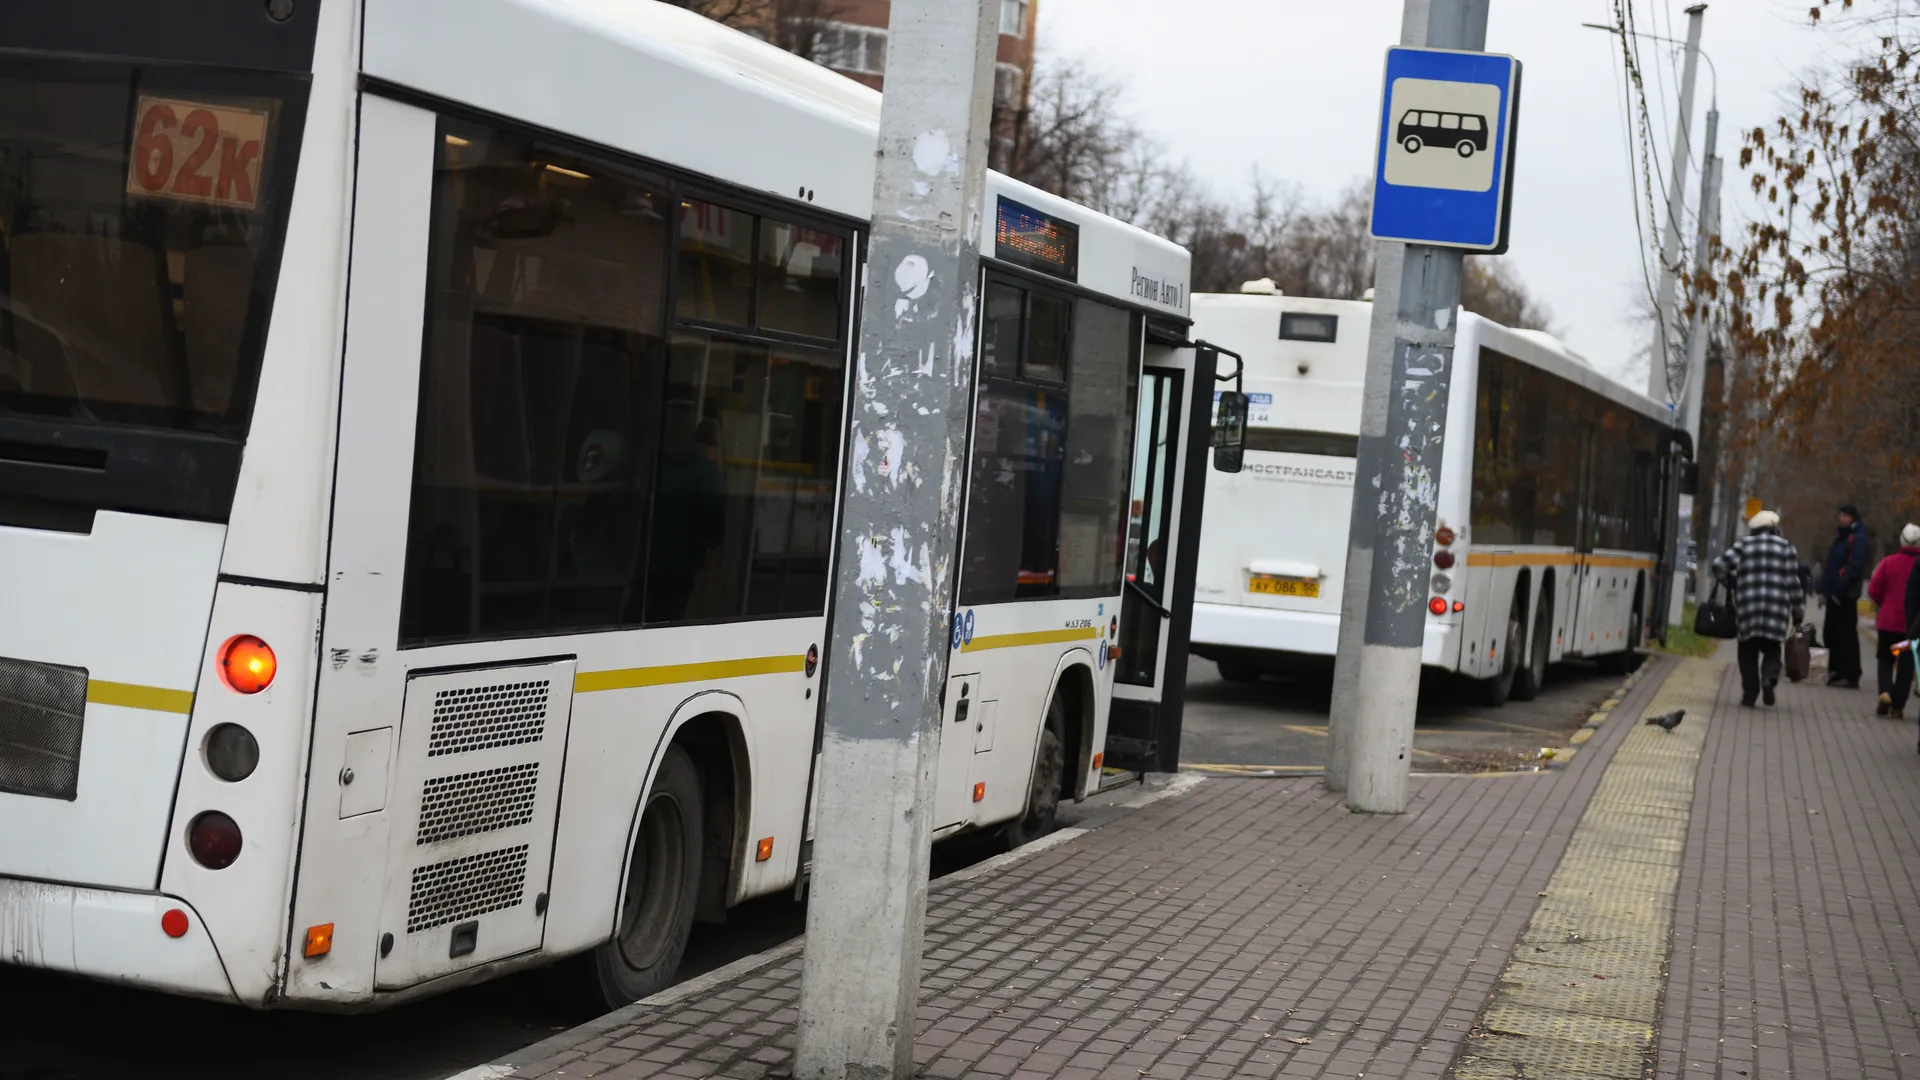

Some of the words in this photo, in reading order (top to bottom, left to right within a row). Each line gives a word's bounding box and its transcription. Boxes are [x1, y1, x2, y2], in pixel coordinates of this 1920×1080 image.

[1130, 266, 1158, 301] Регион
[1158, 277, 1178, 307] Авто
[1242, 463, 1355, 480] МОСТРАНСАВТ
[1274, 581, 1297, 593] 086
[1079, 619, 1091, 628] 206
